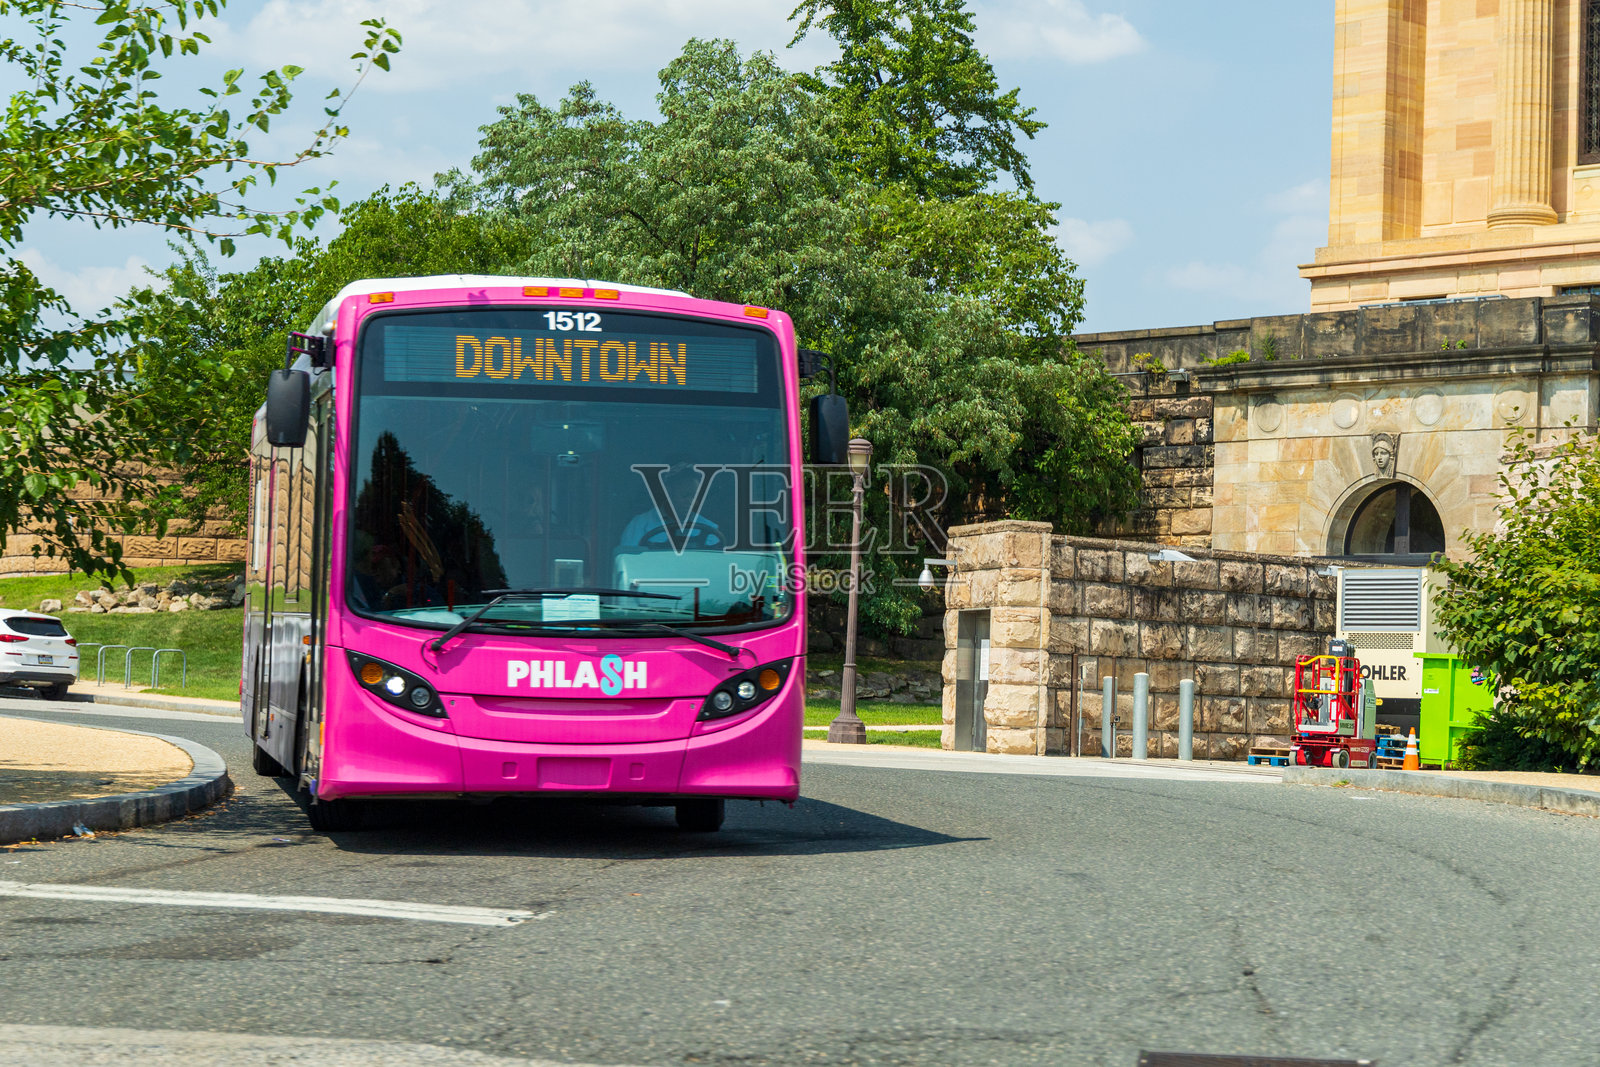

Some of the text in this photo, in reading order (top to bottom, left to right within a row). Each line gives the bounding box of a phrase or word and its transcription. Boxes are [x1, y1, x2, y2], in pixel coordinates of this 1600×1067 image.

[543, 311, 602, 332] 1512
[456, 335, 686, 385] DOWNTOWN
[507, 654, 647, 696] PHLASH
[1360, 665, 1407, 681] OHLER
